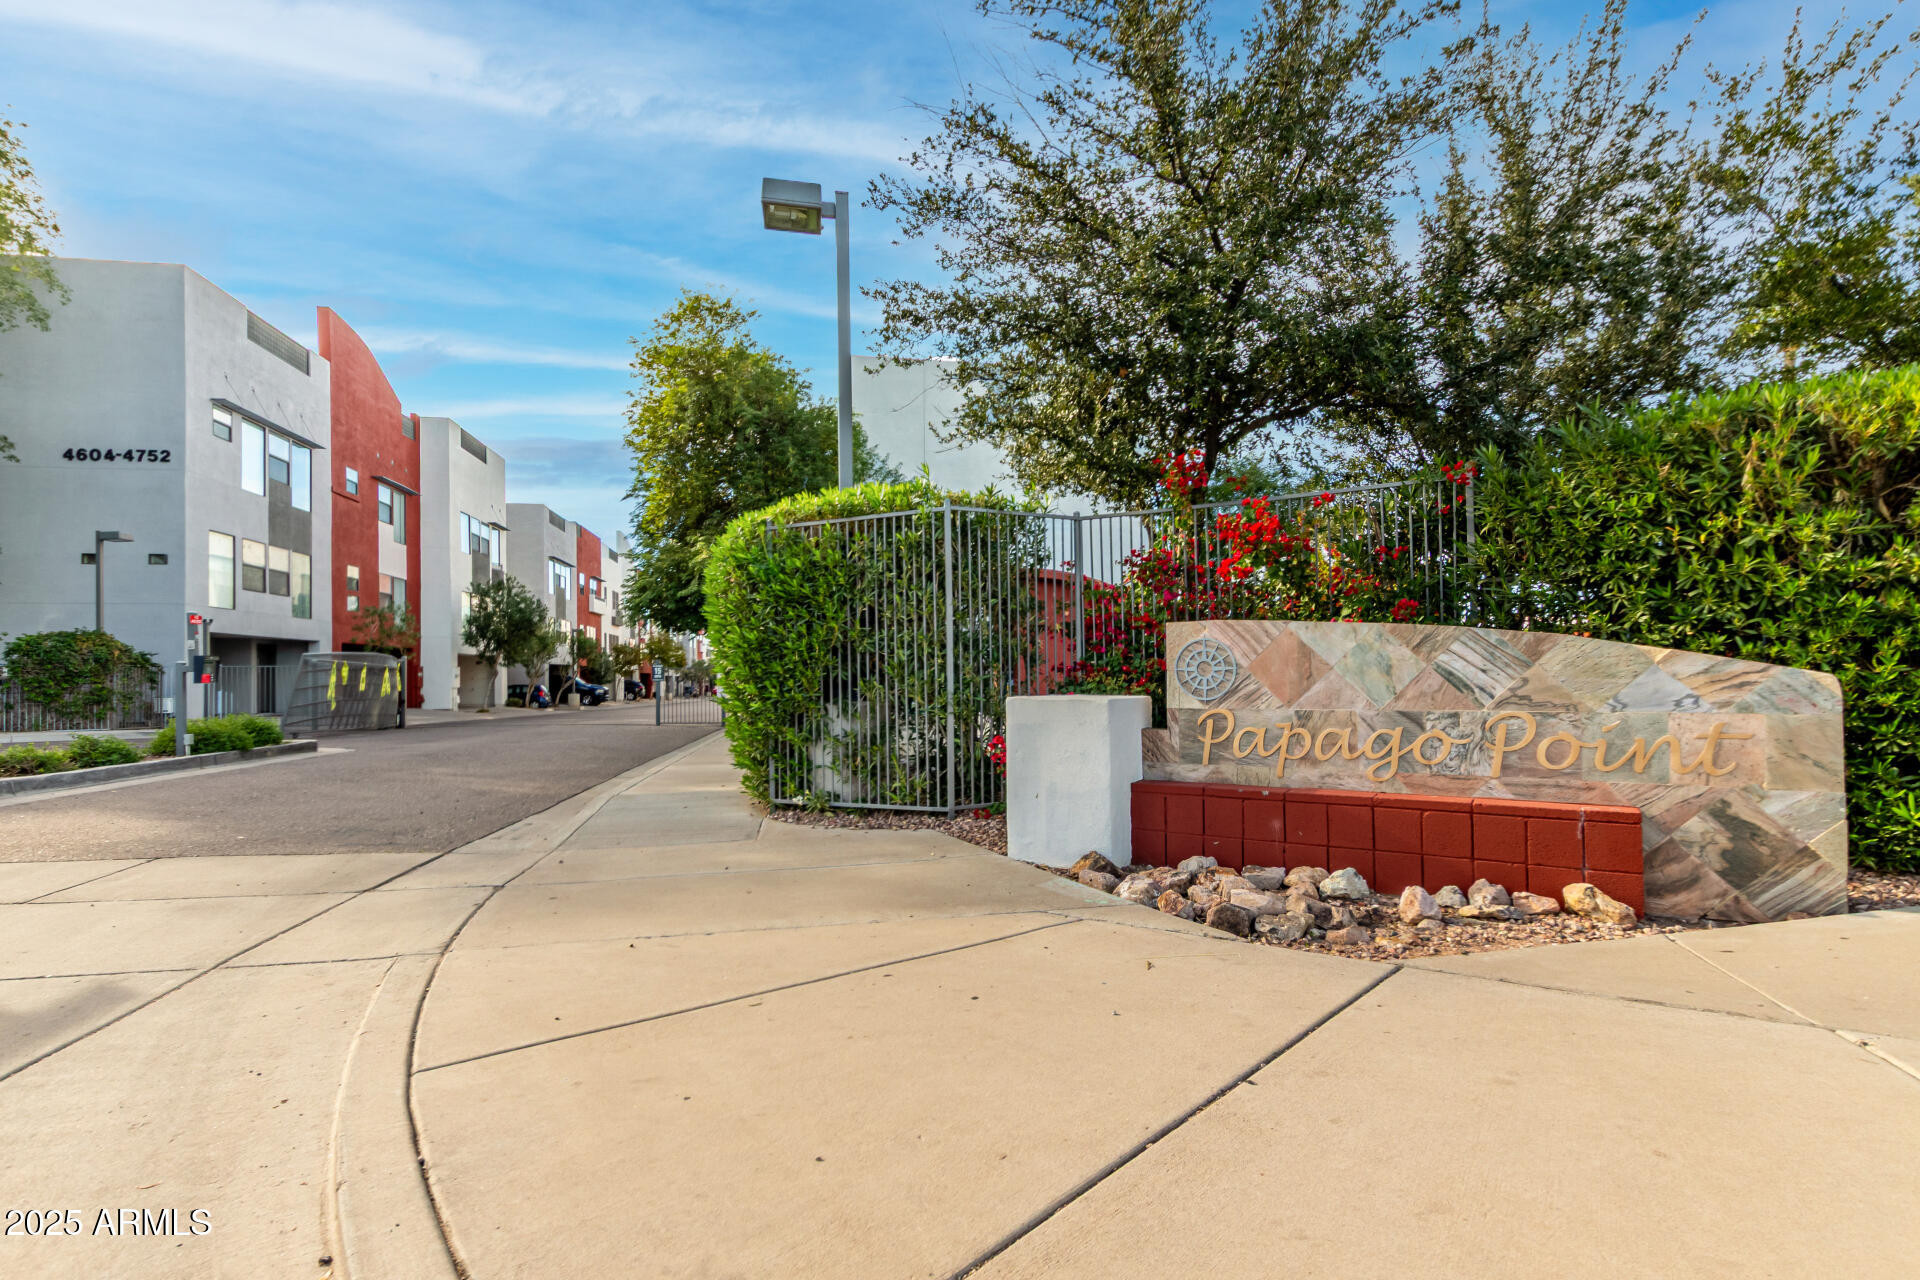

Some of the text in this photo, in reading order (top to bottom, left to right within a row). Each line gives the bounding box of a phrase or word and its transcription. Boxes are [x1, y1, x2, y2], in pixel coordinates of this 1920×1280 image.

[62, 448, 171, 462] 4604-4752
[1197, 708, 1753, 782] Papago Point
